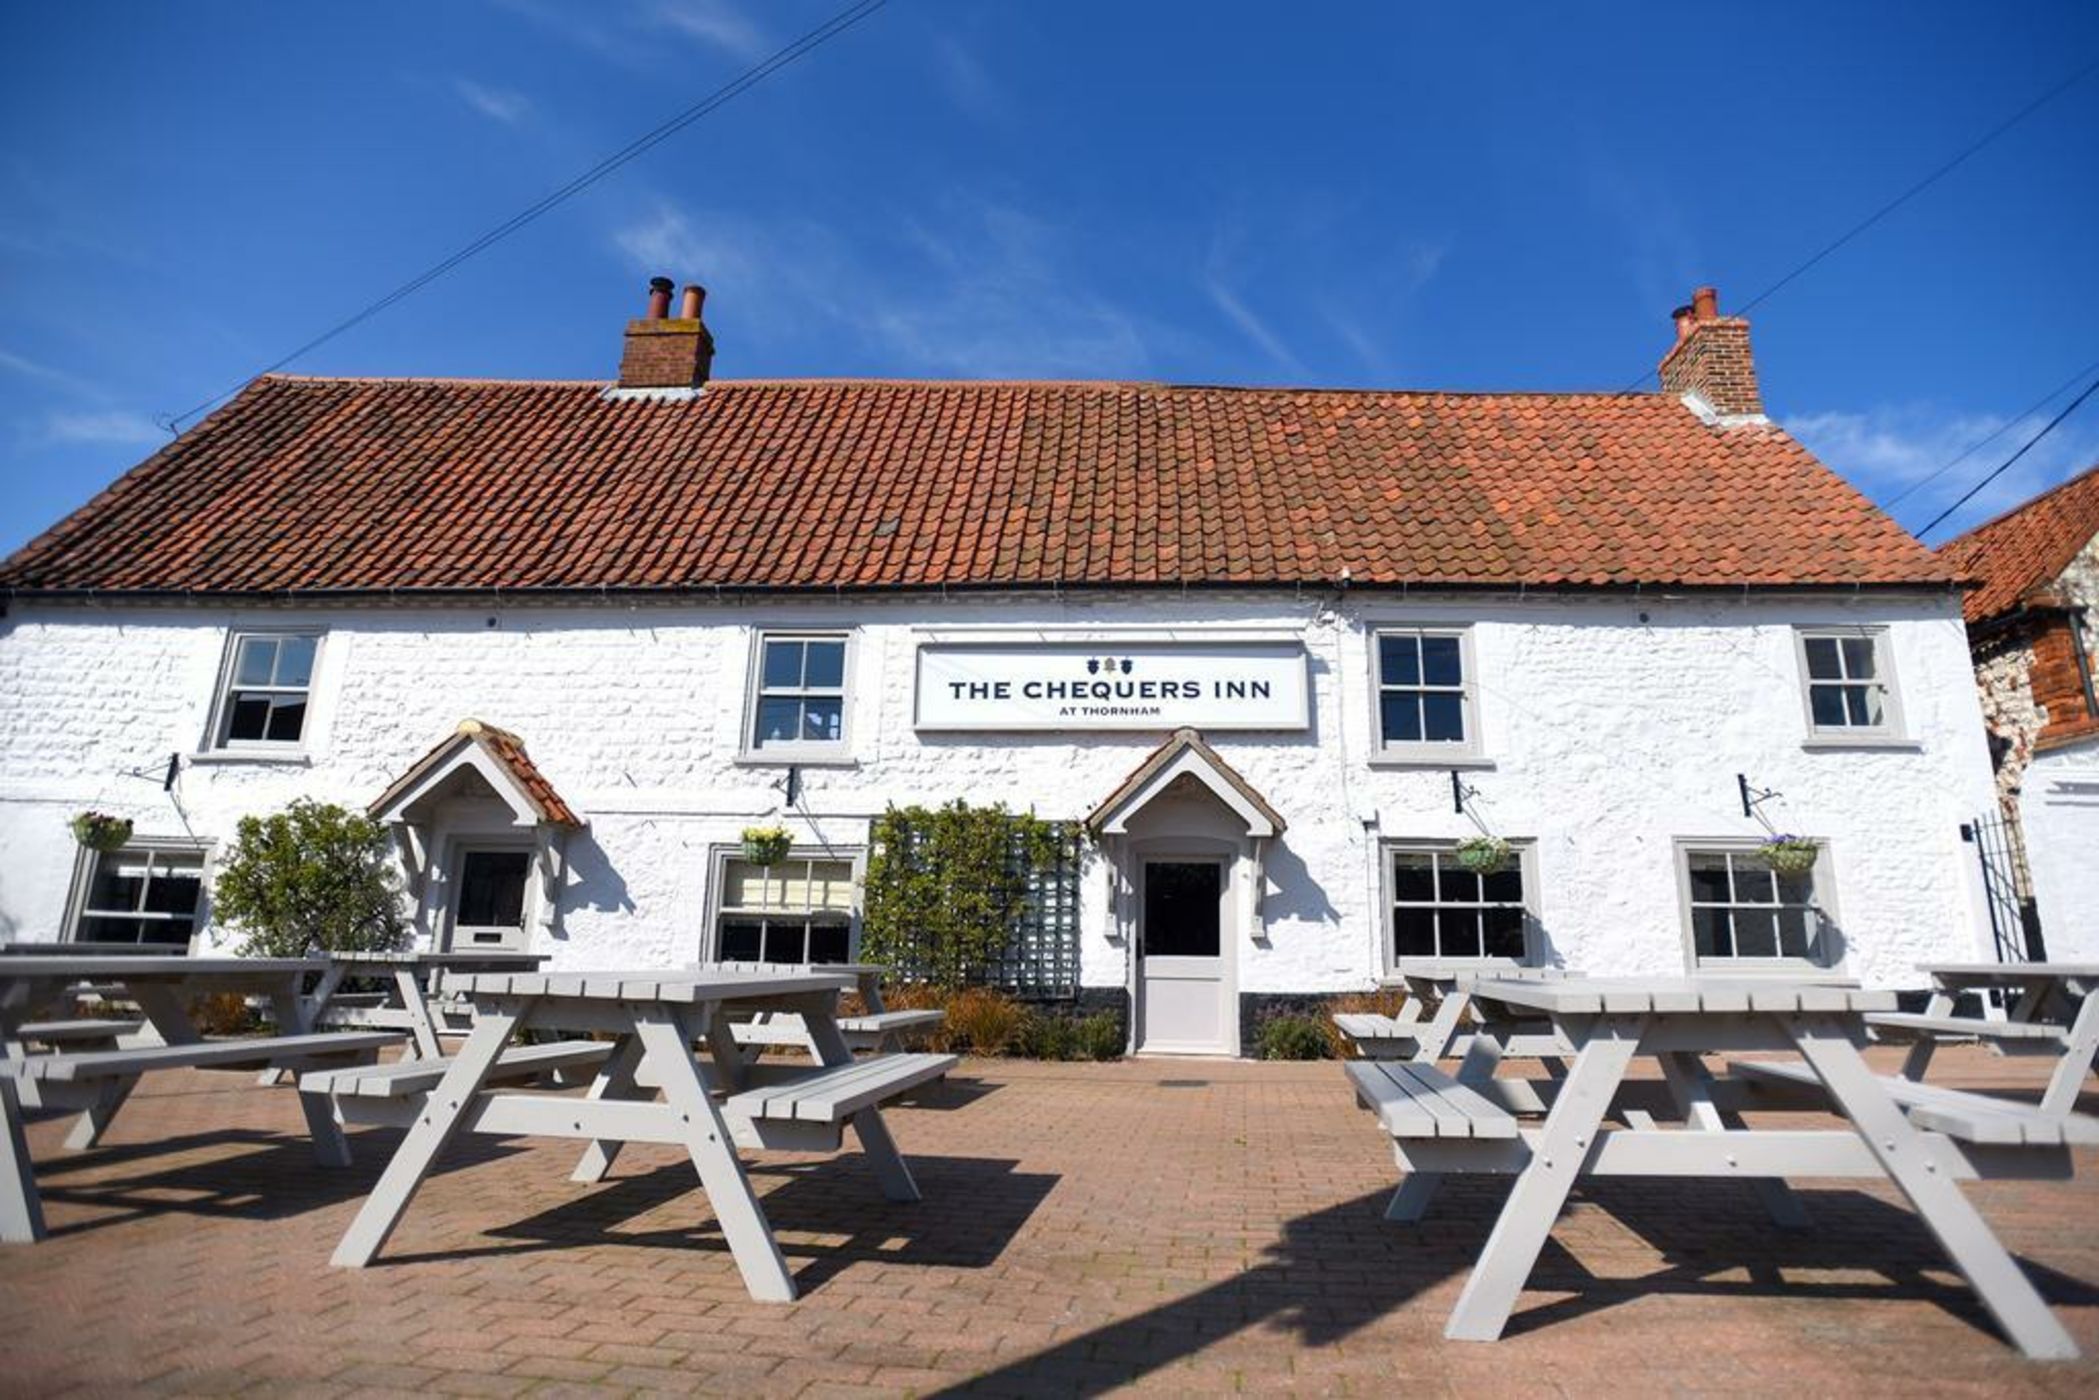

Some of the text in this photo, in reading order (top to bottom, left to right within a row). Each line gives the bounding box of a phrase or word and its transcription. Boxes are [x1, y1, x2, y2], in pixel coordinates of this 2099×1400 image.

[948, 681, 1270, 701] THE CHEQUERS INN
[1059, 706, 1161, 716] AT THORNHAM
